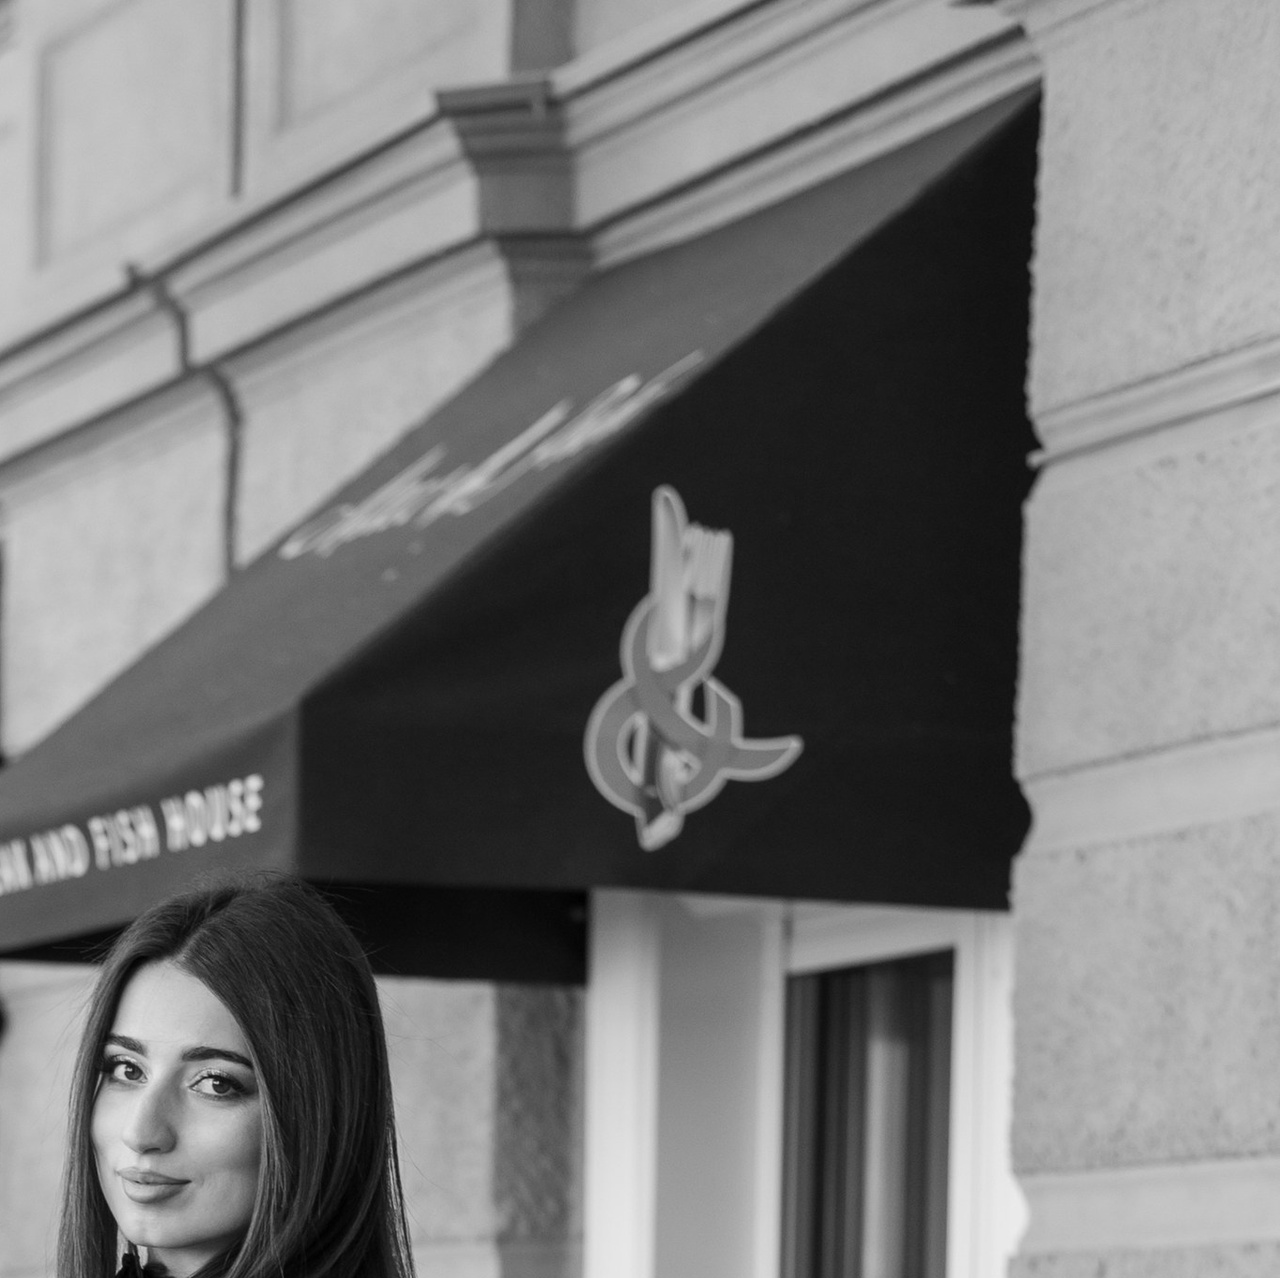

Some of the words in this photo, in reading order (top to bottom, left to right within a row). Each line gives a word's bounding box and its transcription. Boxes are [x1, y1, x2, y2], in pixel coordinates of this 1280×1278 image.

[30, 823, 91, 887] AND
[88, 804, 161, 871] FISH
[160, 772, 265, 852] HOUSE
